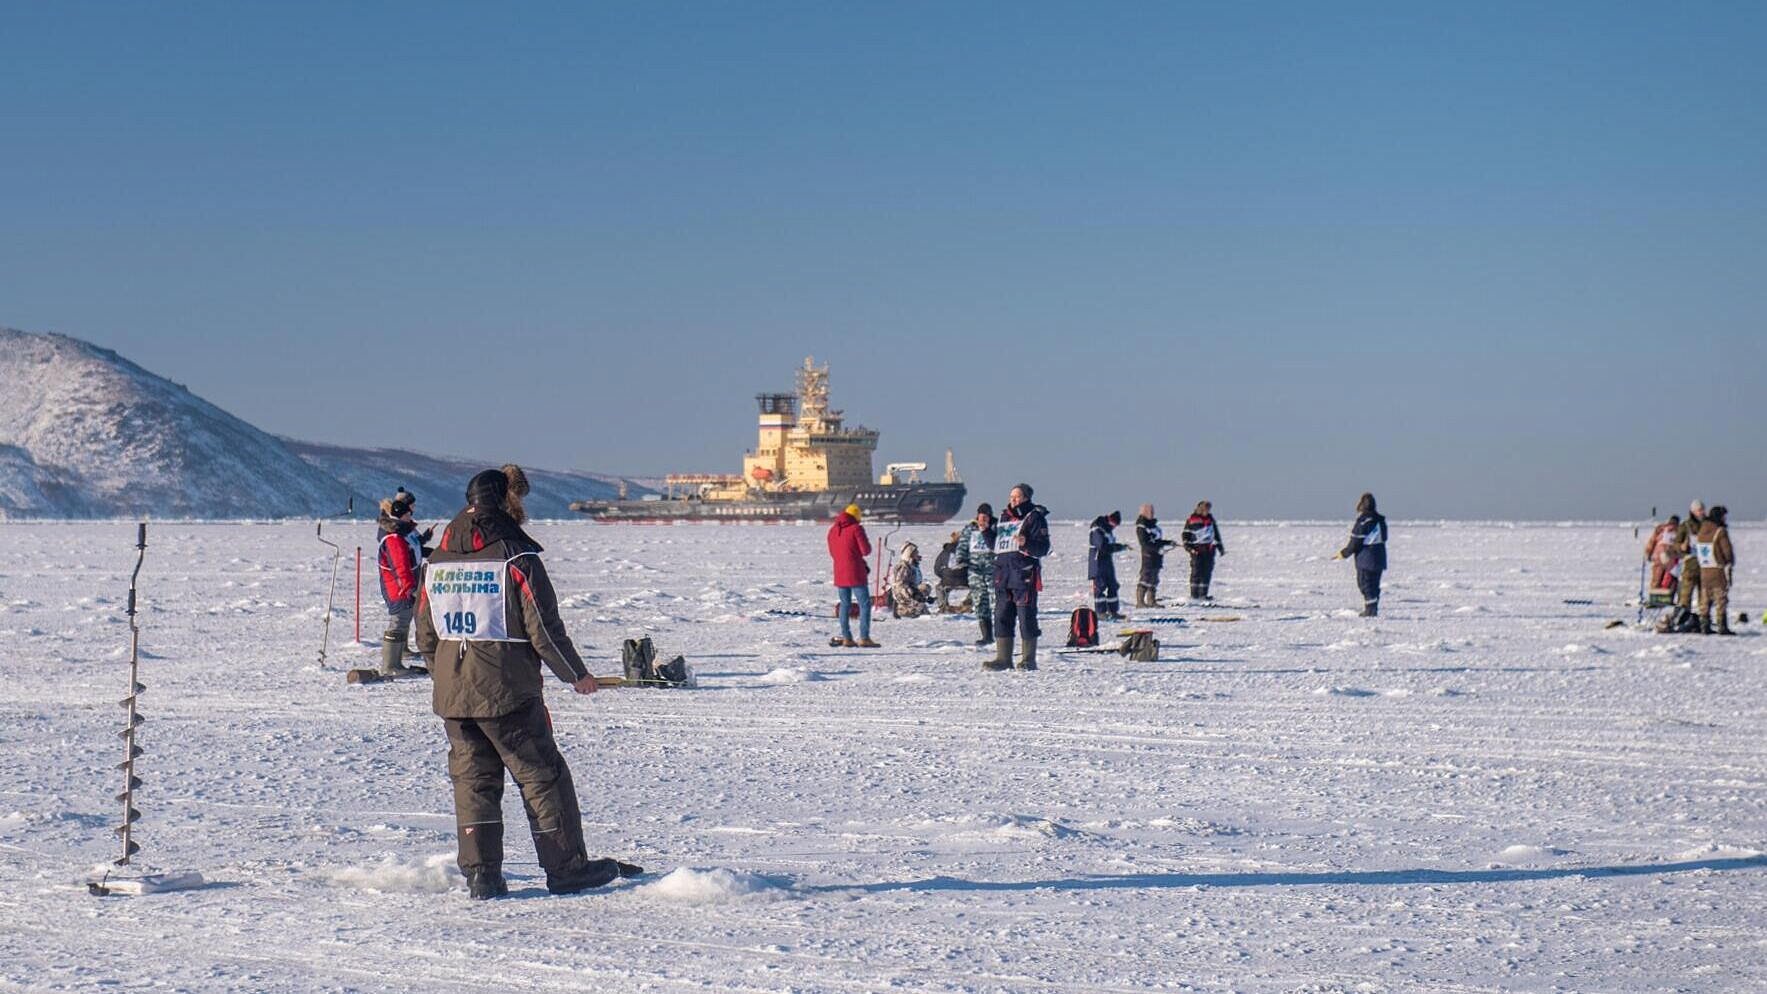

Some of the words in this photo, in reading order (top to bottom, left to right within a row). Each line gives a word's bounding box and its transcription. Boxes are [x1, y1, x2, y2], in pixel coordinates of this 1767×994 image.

[433, 568, 495, 581] Клёвая
[432, 583, 499, 594] Колыма
[444, 611, 477, 634] 149
